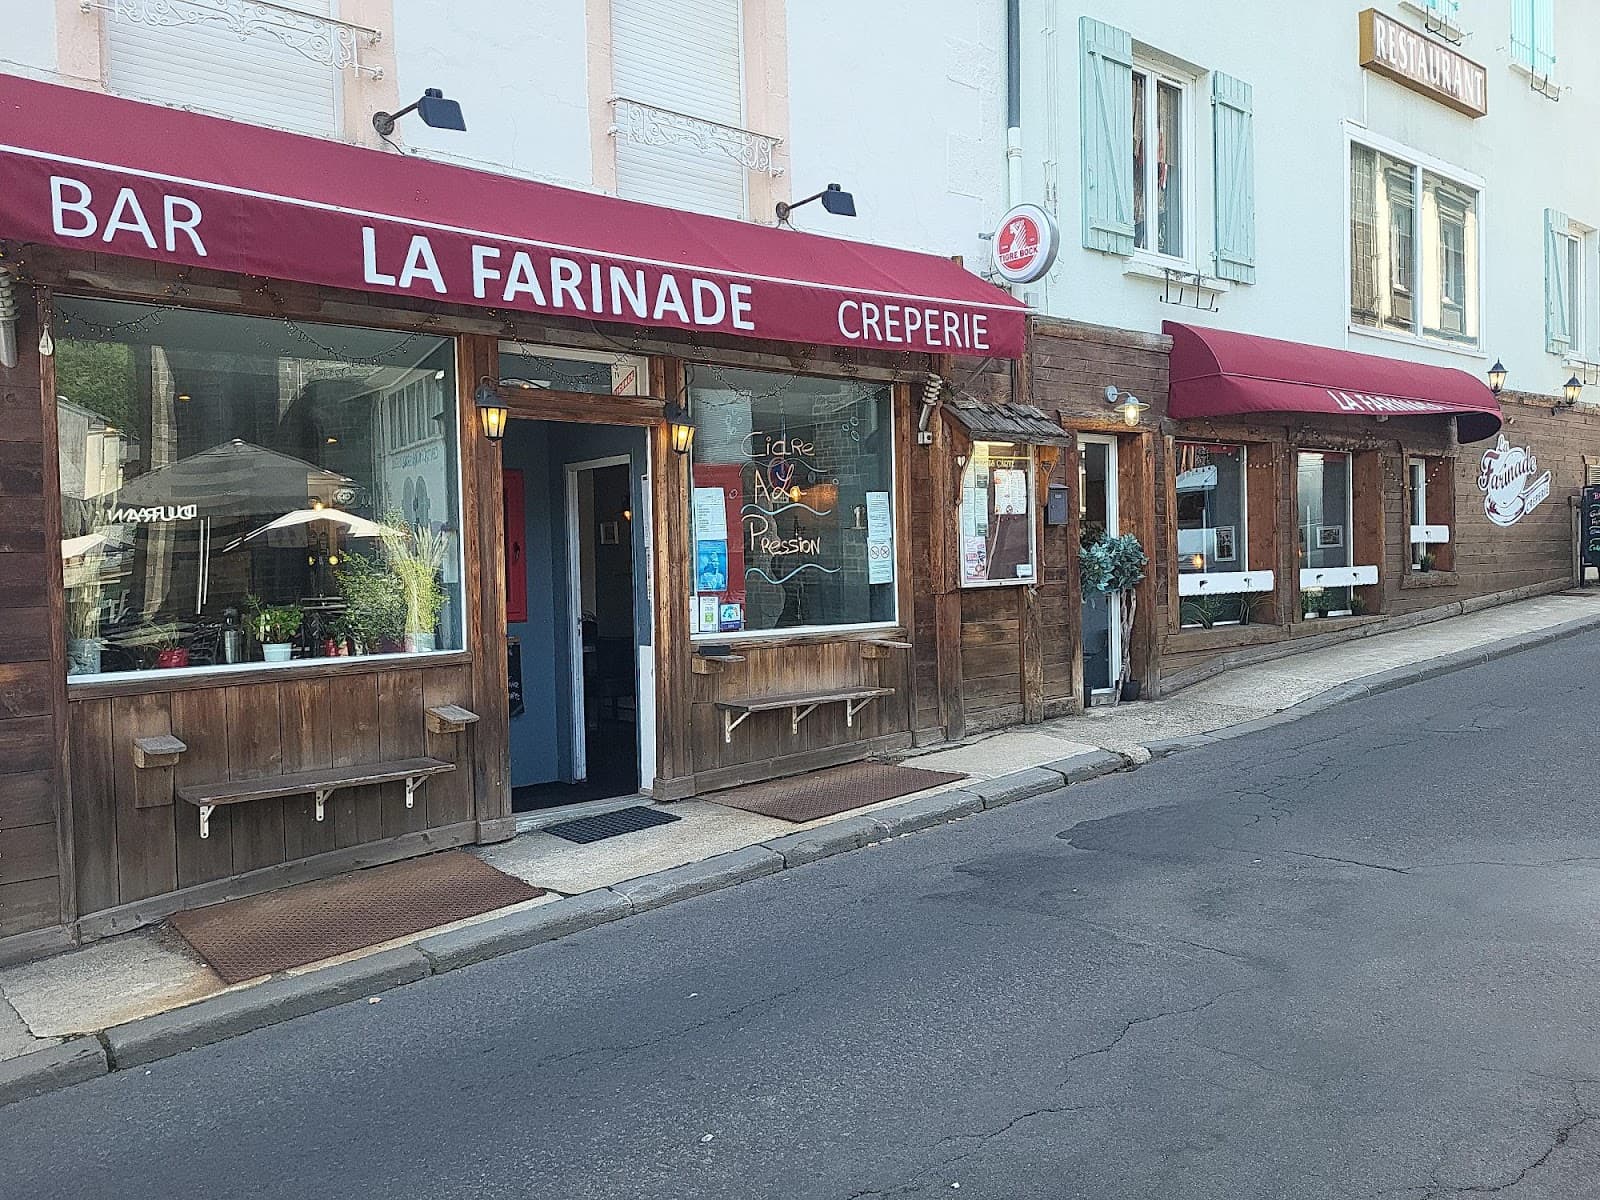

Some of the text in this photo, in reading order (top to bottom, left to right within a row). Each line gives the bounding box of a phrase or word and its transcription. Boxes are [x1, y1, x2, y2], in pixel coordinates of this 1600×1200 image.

[1375, 17, 1483, 106] RESTAURANT
[49, 175, 208, 257] BAR
[362, 226, 755, 331] LA FARINADE
[999, 245, 1039, 262] TIGRE BOCK
[837, 299, 990, 350] CREPERIE
[1327, 390, 1365, 411] LA
[1478, 448, 1537, 490] Farinade
